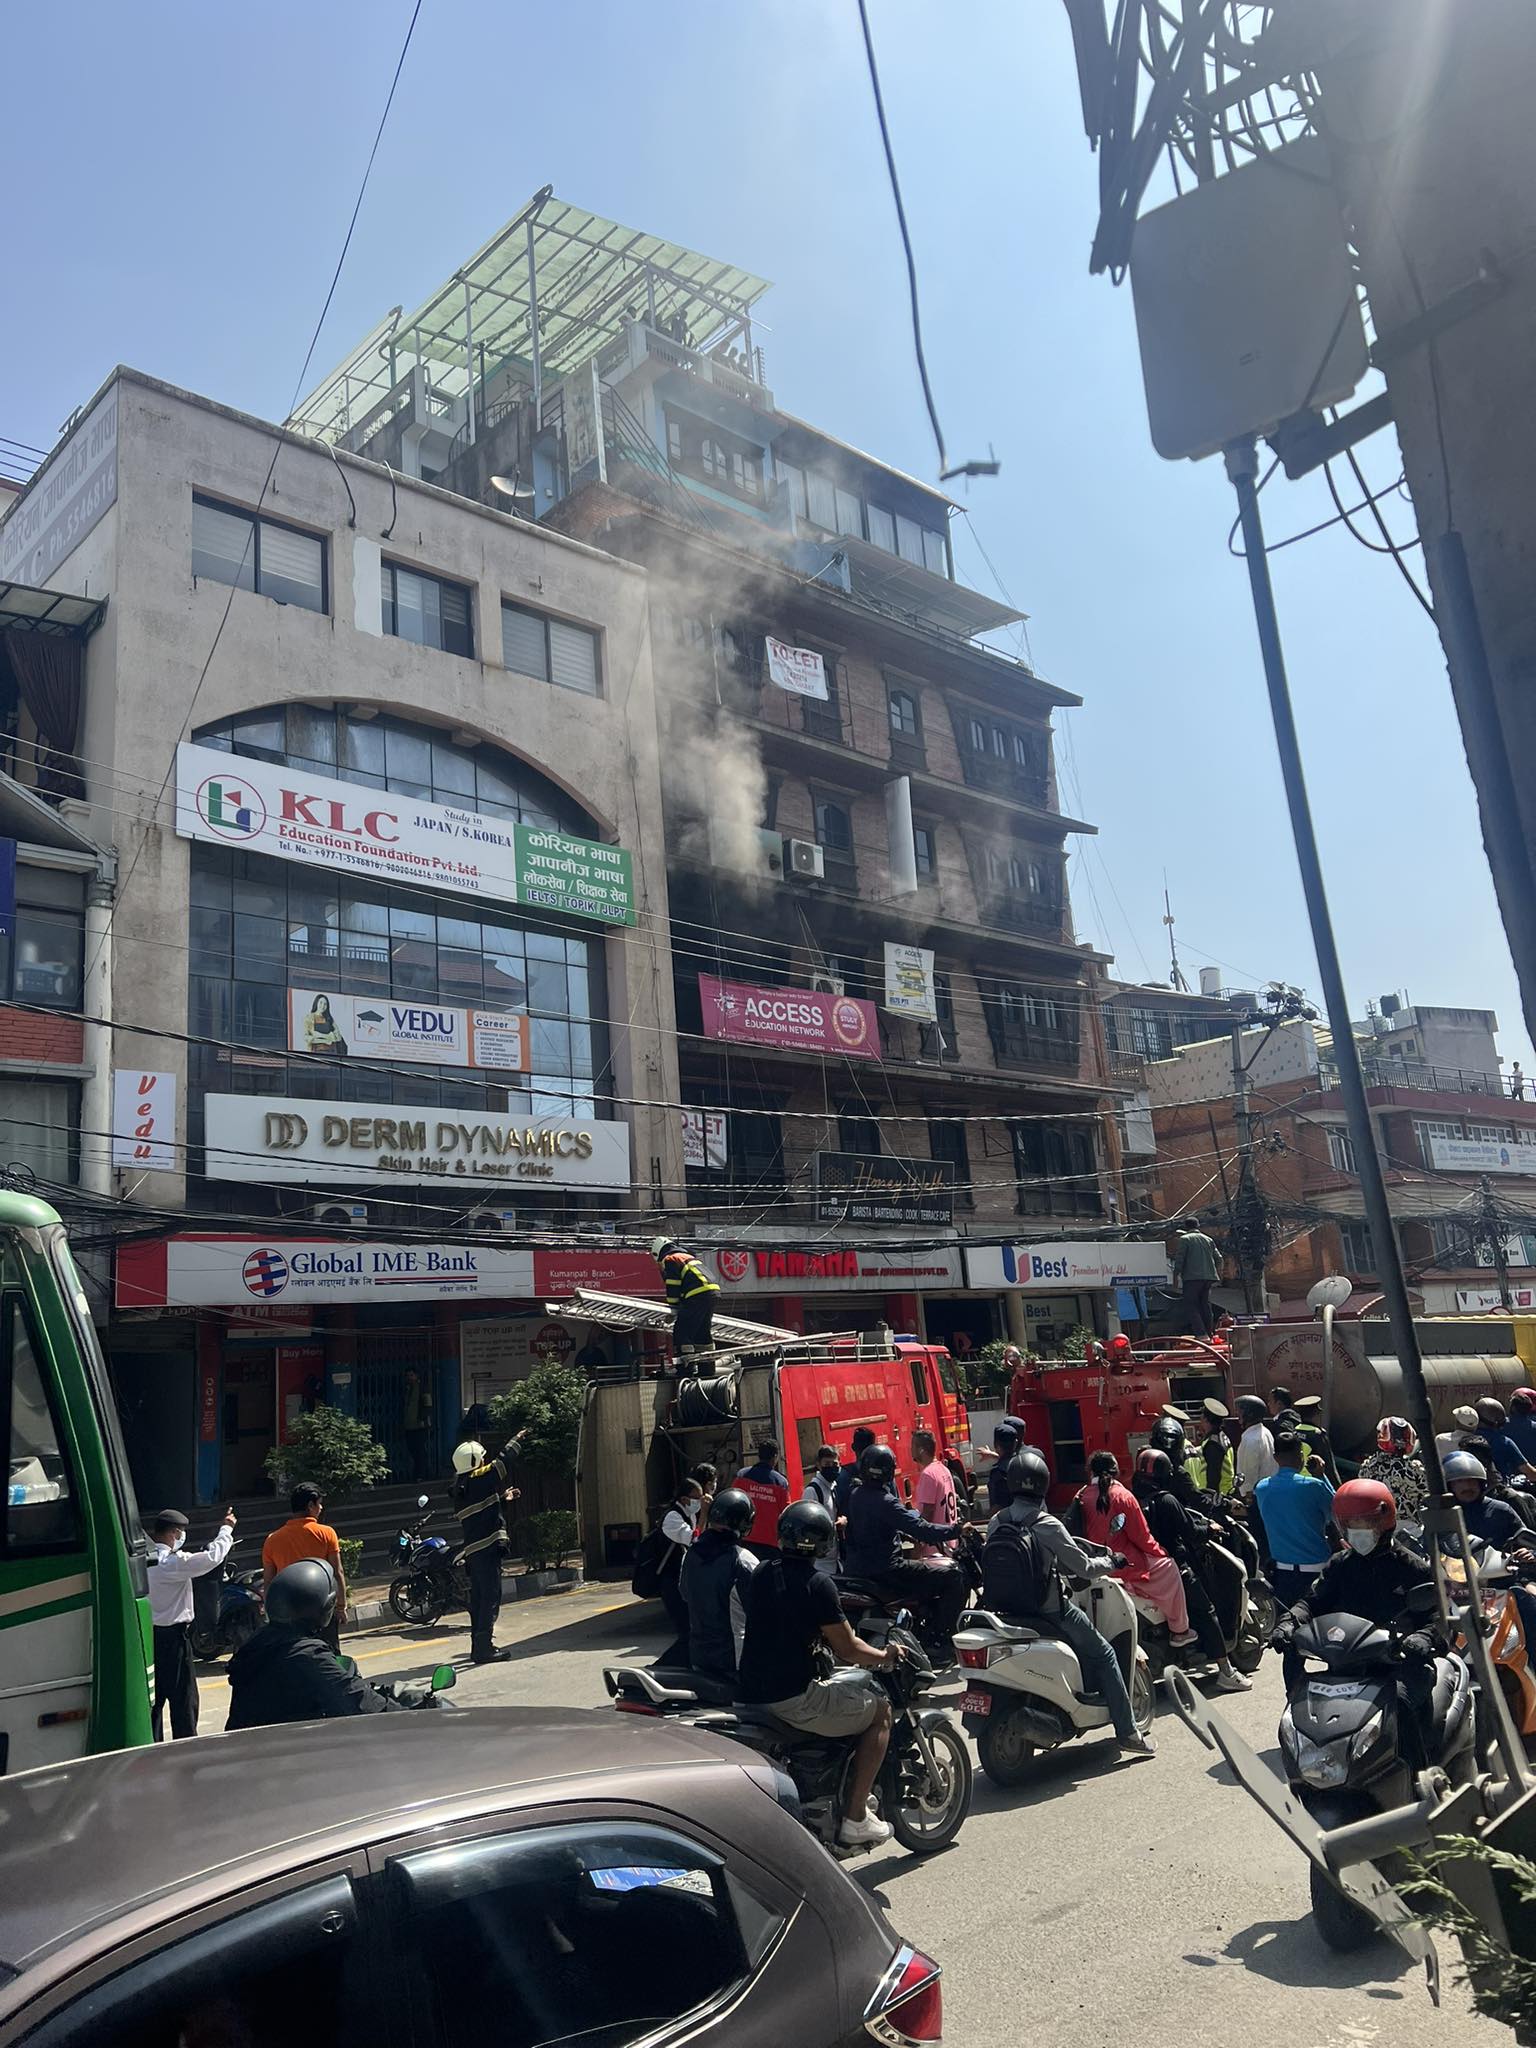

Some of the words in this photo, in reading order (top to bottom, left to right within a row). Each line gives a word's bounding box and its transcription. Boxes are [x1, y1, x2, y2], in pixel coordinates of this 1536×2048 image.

[770, 643, 819, 669] TO-LET
[279, 789, 399, 842] KLC
[443, 808, 471, 825] Study
[473, 814, 482, 825] in
[413, 816, 451, 834] JAPAN
[462, 827, 511, 847] S.KOREA
[279, 824, 351, 851] Education
[354, 840, 428, 866] Foundation
[279, 841, 292, 851] Tel.
[528, 832, 586, 857] कोरियन
[591, 846, 621, 865] भाषा
[526, 851, 589, 877] जापानीज
[594, 865, 624, 885] भाषा
[523, 869, 565, 891] लोकसेवा
[577, 879, 607, 899] शिक्षक
[610, 885, 627, 903] सेवा
[527, 888, 556, 905] IELTS
[565, 897, 595, 912] TOPIK
[602, 904, 627, 919] JLPT
[391, 1008, 454, 1034] VEDU
[476, 1018, 508, 1028] Career
[745, 998, 824, 1026] ACCESS
[392, 1030, 419, 1041] GLOBAL
[421, 1033, 453, 1043] INSTITUTE
[745, 1020, 787, 1033] EDUCATION
[789, 1026, 825, 1038] NETWORK
[133, 1075, 157, 1159] Vedu
[323, 1115, 426, 1151] DERM
[437, 1122, 593, 1159] DYNAMICS
[378, 1154, 411, 1171] Skin
[419, 1156, 449, 1174] Hair
[455, 1159, 466, 1174] &
[472, 1160, 513, 1176] Laser
[518, 1162, 554, 1178] Clinic
[291, 1252, 362, 1274] Global
[373, 1252, 418, 1272] IME
[426, 1250, 477, 1272] Bank
[550, 1270, 588, 1279] Kumaripati
[591, 1269, 615, 1278] Branch
[1033, 1255, 1068, 1278] Best
[231, 1305, 269, 1318] ATM
[1026, 1304, 1051, 1317] Best
[750, 1484, 774, 1495] LALITPUR
